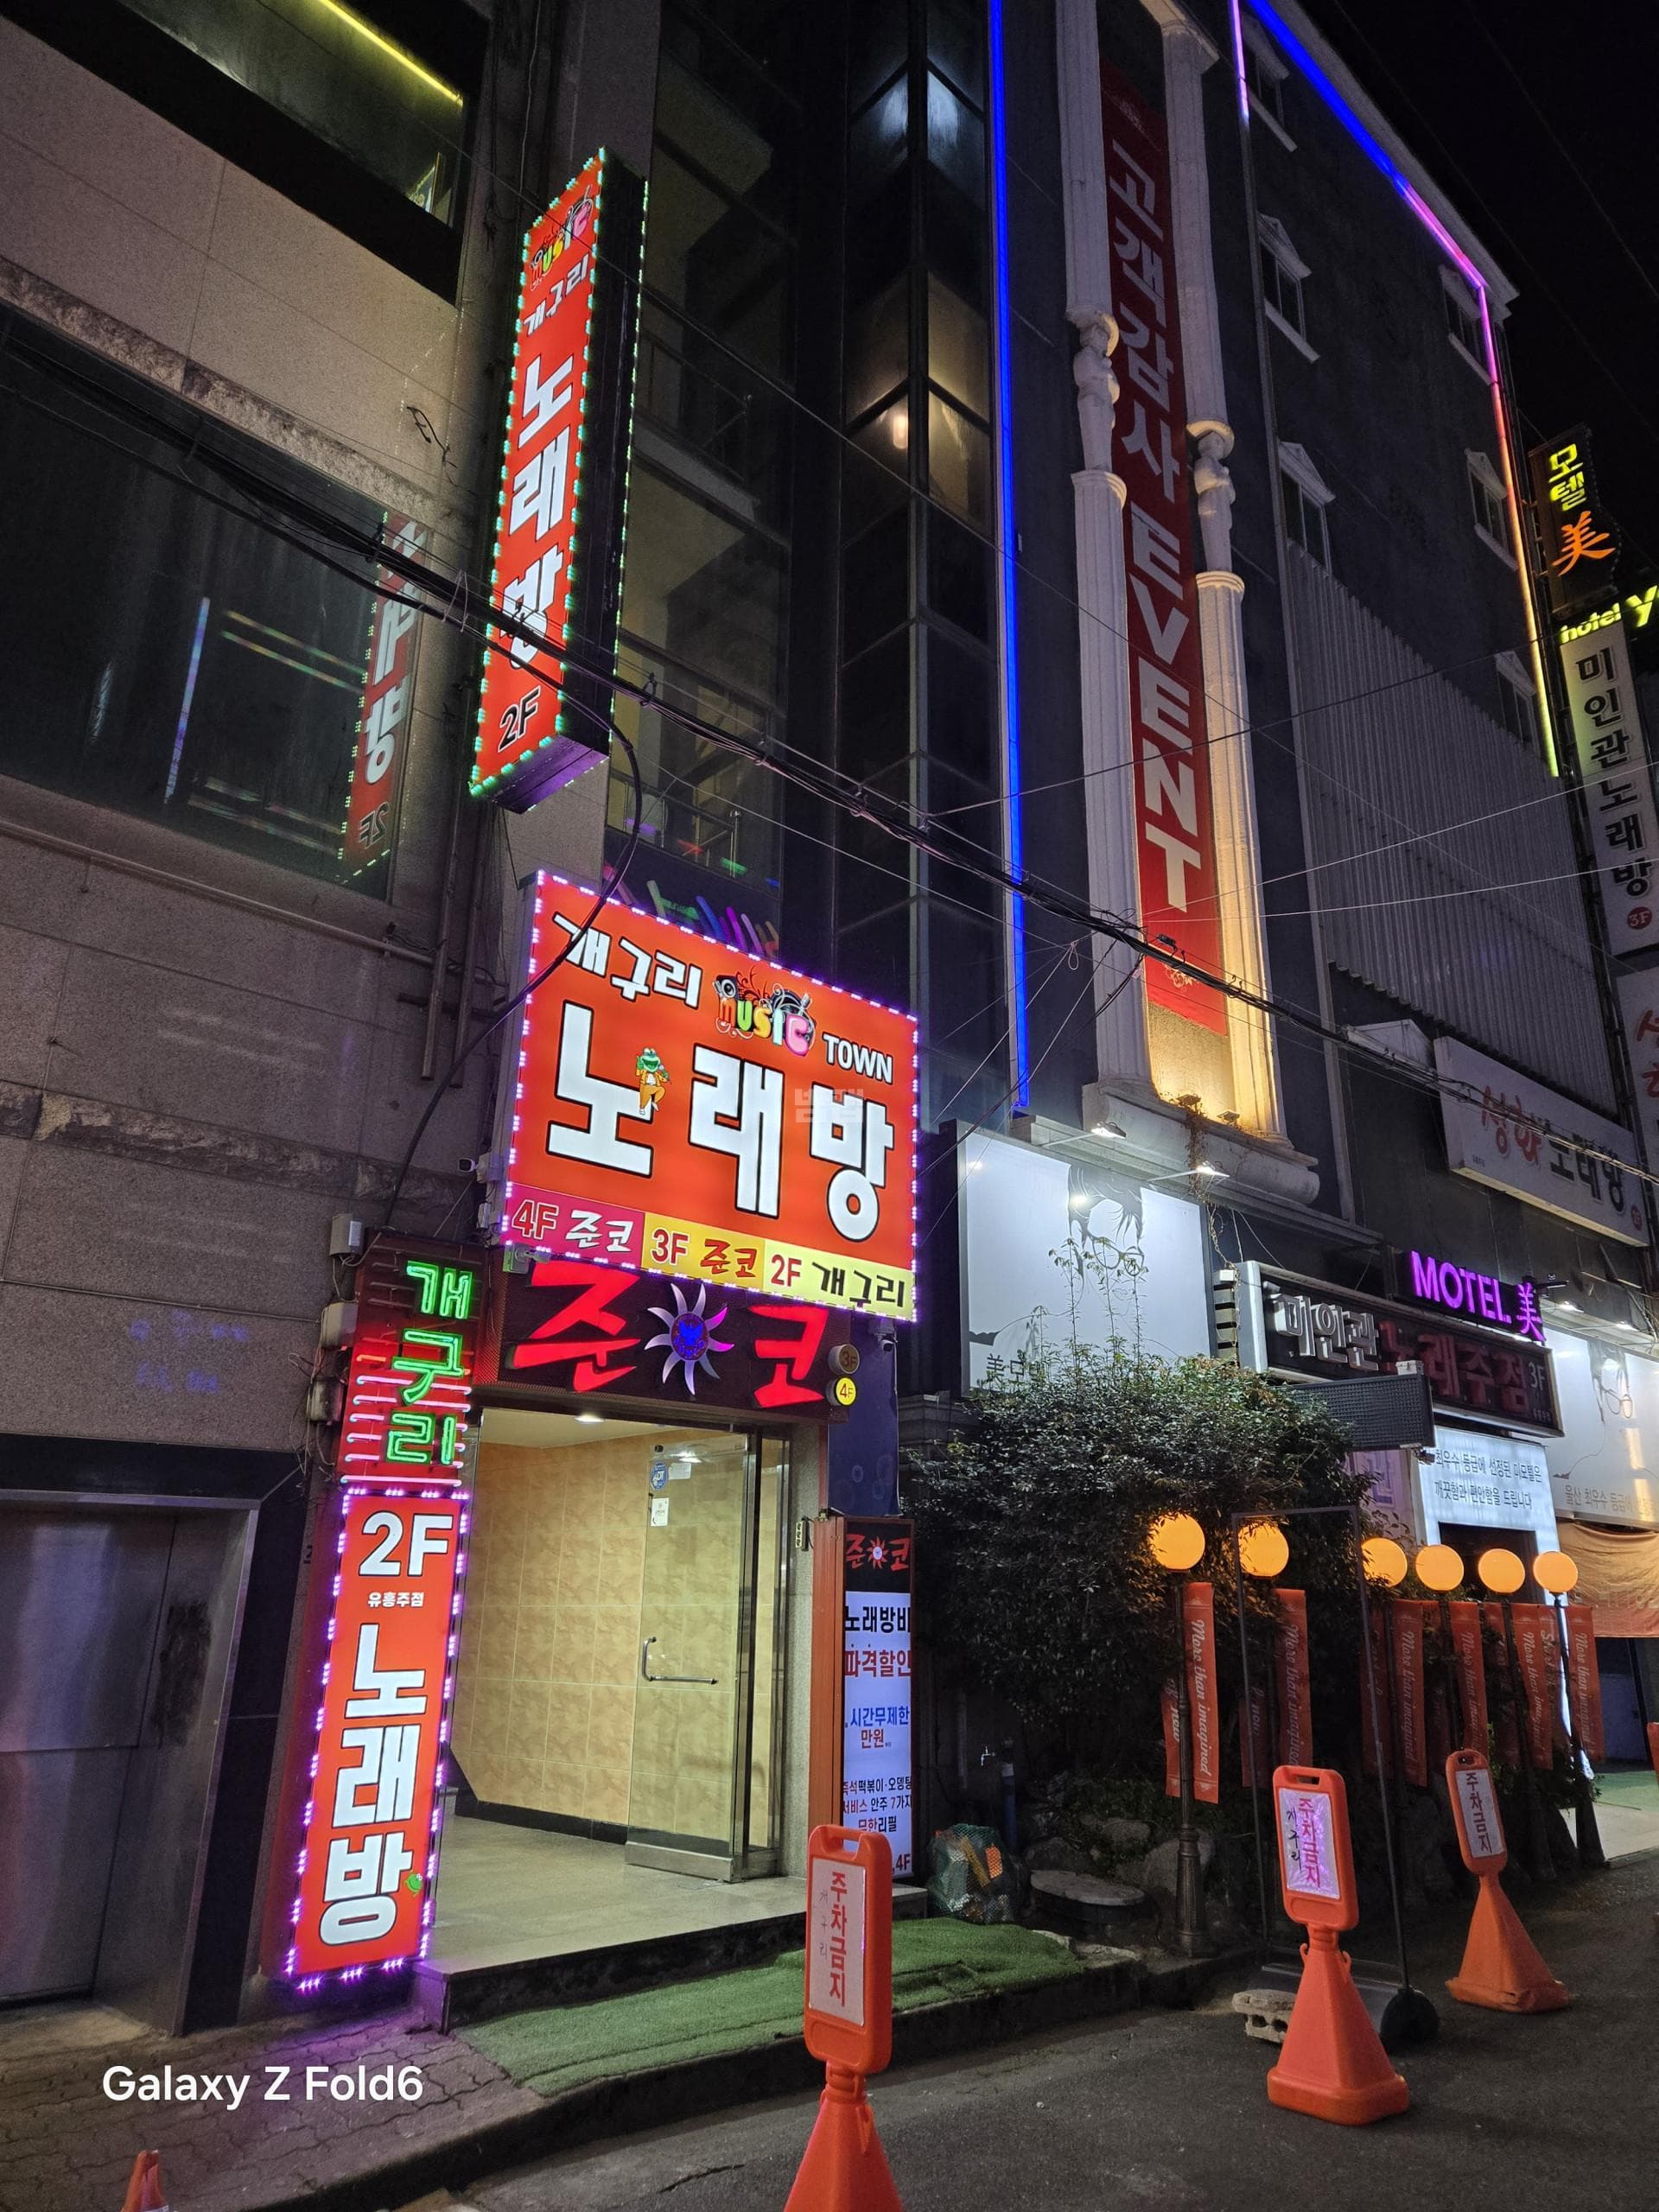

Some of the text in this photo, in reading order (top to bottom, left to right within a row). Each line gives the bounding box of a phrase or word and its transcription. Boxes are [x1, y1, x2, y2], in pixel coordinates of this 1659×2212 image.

[523, 254, 589, 337] 개구리
[499, 353, 575, 670] 노래방
[1549, 443, 1587, 512] 모텔
[1551, 511, 1616, 577] 美
[497, 685, 542, 753] 2F
[1128, 510, 1203, 913] EVENT
[552, 912, 703, 1009] 개구리
[821, 1032, 894, 1084] TOWN
[546, 1000, 895, 1242] 노래방
[512, 1198, 635, 1255] 4F 준코
[650, 1228, 759, 1280] 3F 준코
[770, 1253, 906, 1308] 2F 개구리
[385, 1260, 474, 1465] 개구리
[839, 1382, 854, 1399] 4F
[1528, 1361, 1546, 1392] 3F
[358, 1510, 454, 1577] 2F
[367, 1592, 424, 1608] 유흥주점
[845, 1706, 910, 1727] 시간무제한
[1191, 1619, 1212, 1777] More than imagined
[861, 1728, 884, 1750] 만원
[318, 1623, 428, 1947] 노래방
[870, 1796, 887, 1811] 안주
[1465, 1772, 1493, 1853] 주차금지
[1298, 1797, 1321, 1889] 주차금지
[830, 1872, 848, 2007] 주차금지
